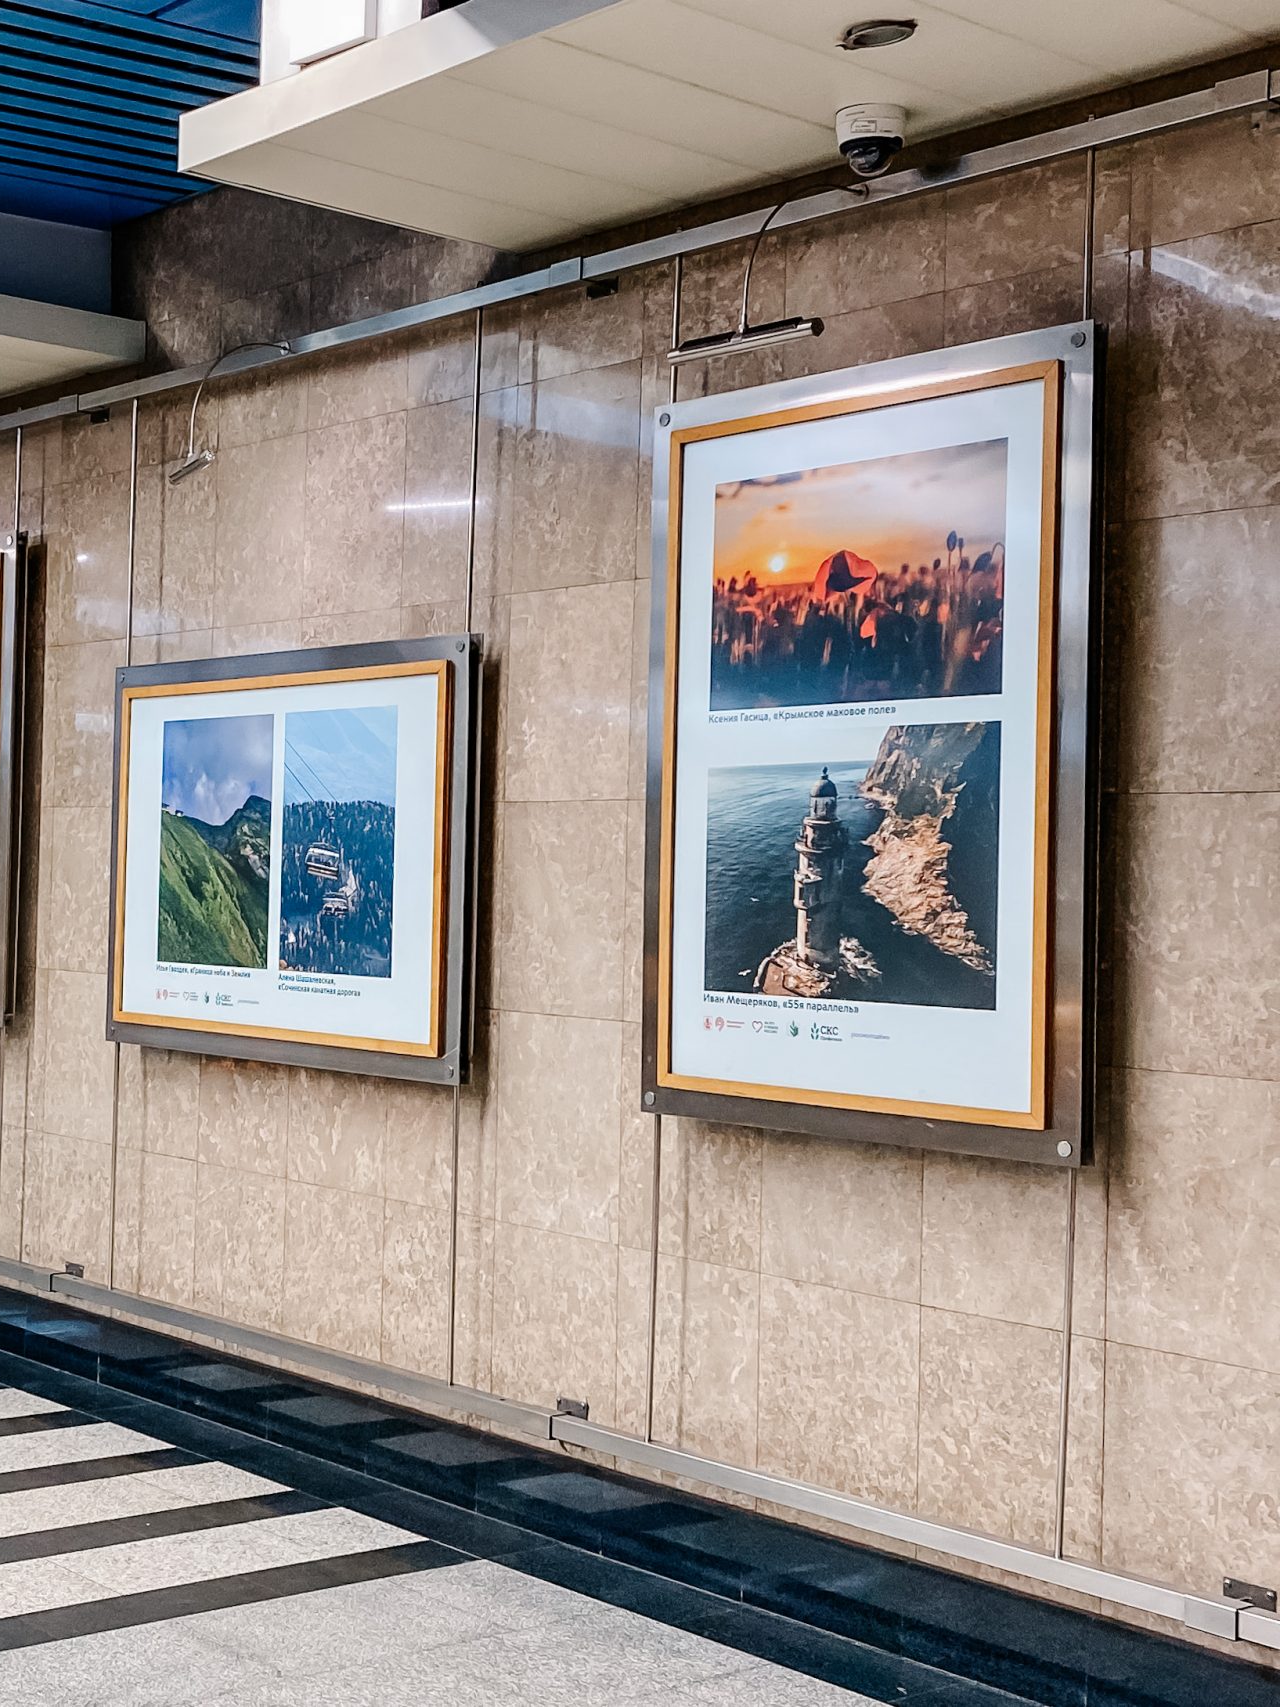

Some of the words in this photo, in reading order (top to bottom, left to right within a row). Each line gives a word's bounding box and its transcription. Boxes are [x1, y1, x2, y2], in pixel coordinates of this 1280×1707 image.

[709, 714, 738, 723] Ксения
[773, 709, 824, 721] «Крымское
[826, 707, 866, 717] маковое
[868, 705, 897, 715] поле»
[704, 993, 724, 1003] Иван
[726, 995, 780, 1008] Мещеряков,
[783, 999, 804, 1009] «55я
[806, 1002, 859, 1013] параллель»
[820, 1025, 839, 1035] СКС
